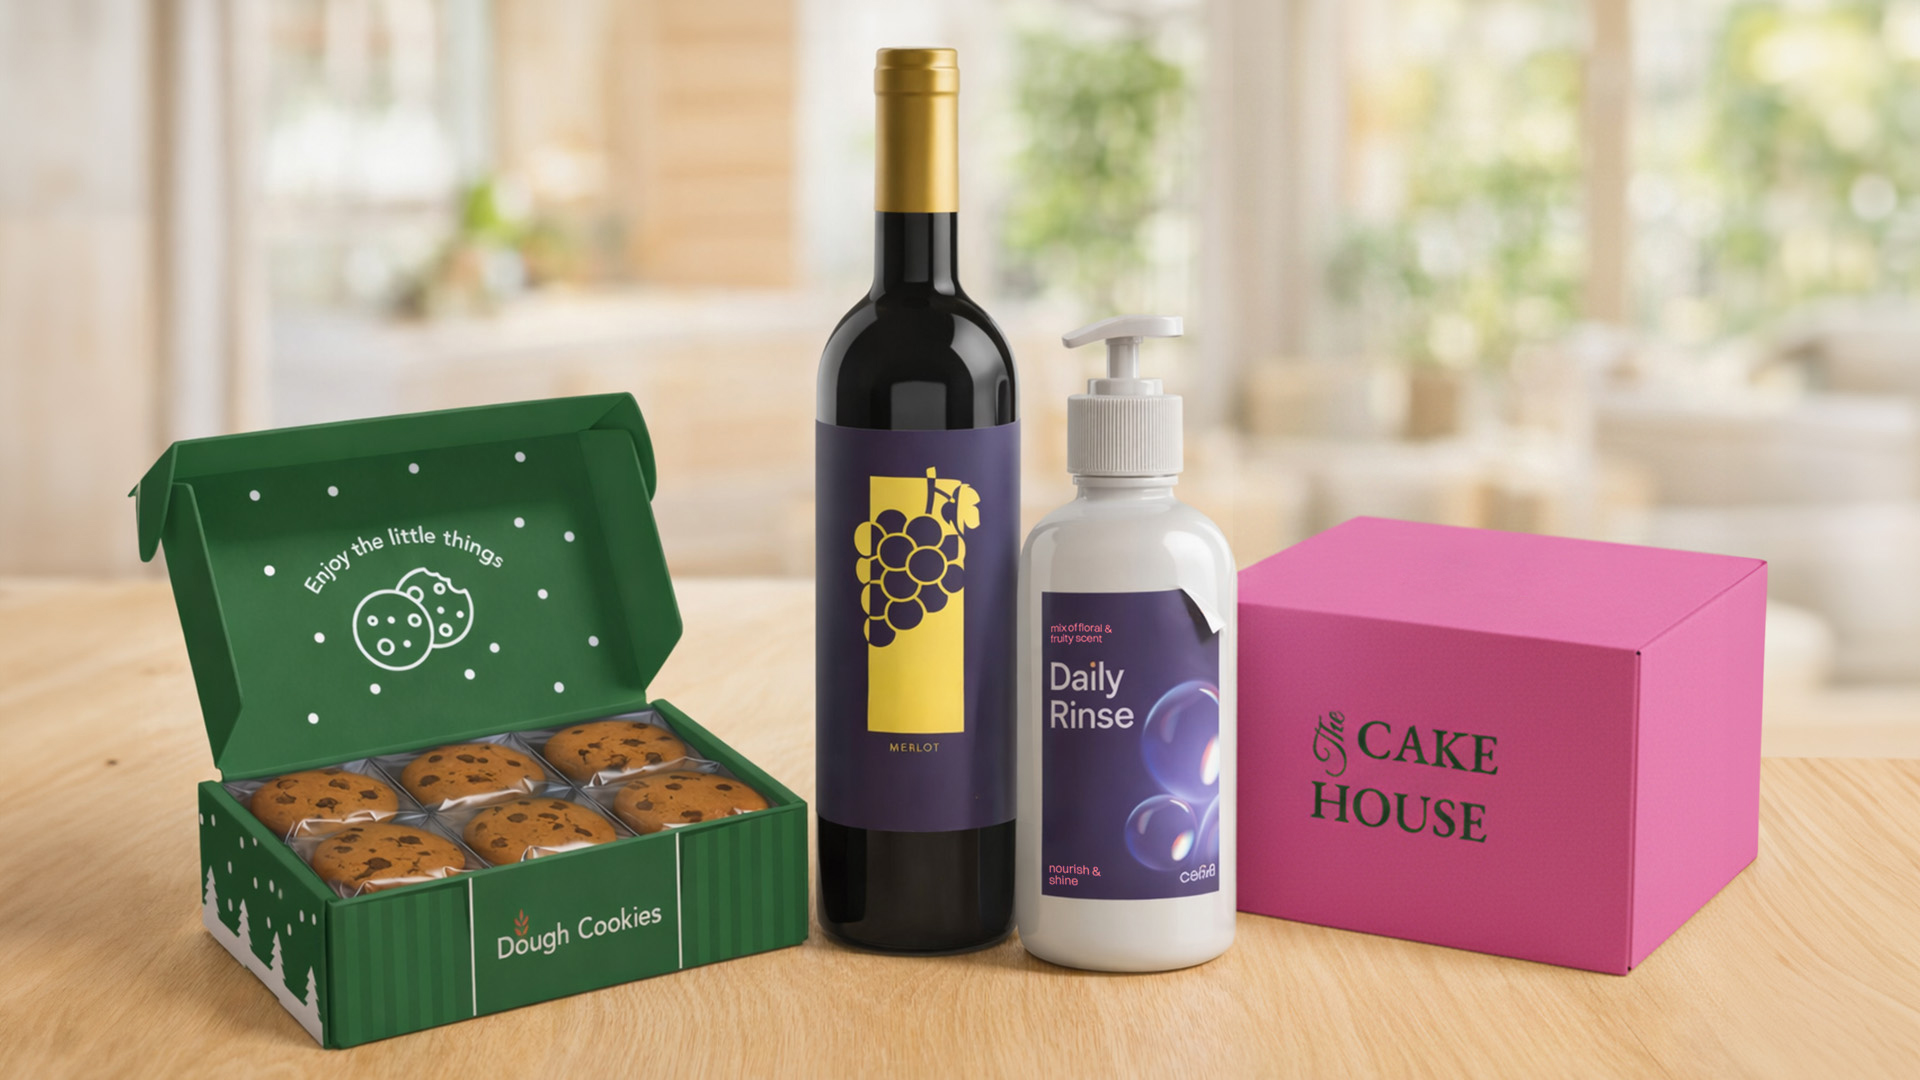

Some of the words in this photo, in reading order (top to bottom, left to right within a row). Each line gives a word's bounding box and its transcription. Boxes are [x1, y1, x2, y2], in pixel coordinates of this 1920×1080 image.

[304, 551, 350, 595] Enjoy
[351, 536, 385, 557] the
[387, 525, 436, 546] little
[443, 530, 504, 568] things
[1050, 623, 1067, 633] mix
[1068, 623, 1078, 633] of
[1078, 623, 1103, 633] floral
[1104, 624, 1113, 634] &
[1050, 634, 1075, 645] fruity
[1075, 635, 1103, 644] scent
[1050, 661, 1125, 699] Daily
[1050, 700, 1134, 729] Rinse
[889, 742, 940, 753] MERLOT
[1313, 710, 1347, 777] The
[1357, 720, 1498, 775] CAKE
[1310, 781, 1487, 843] HOUSE
[1048, 863, 1090, 876] nourish
[1091, 866, 1101, 877] &
[1048, 874, 1079, 886] shine
[497, 922, 569, 959] Dough
[578, 906, 662, 939] Cookies
